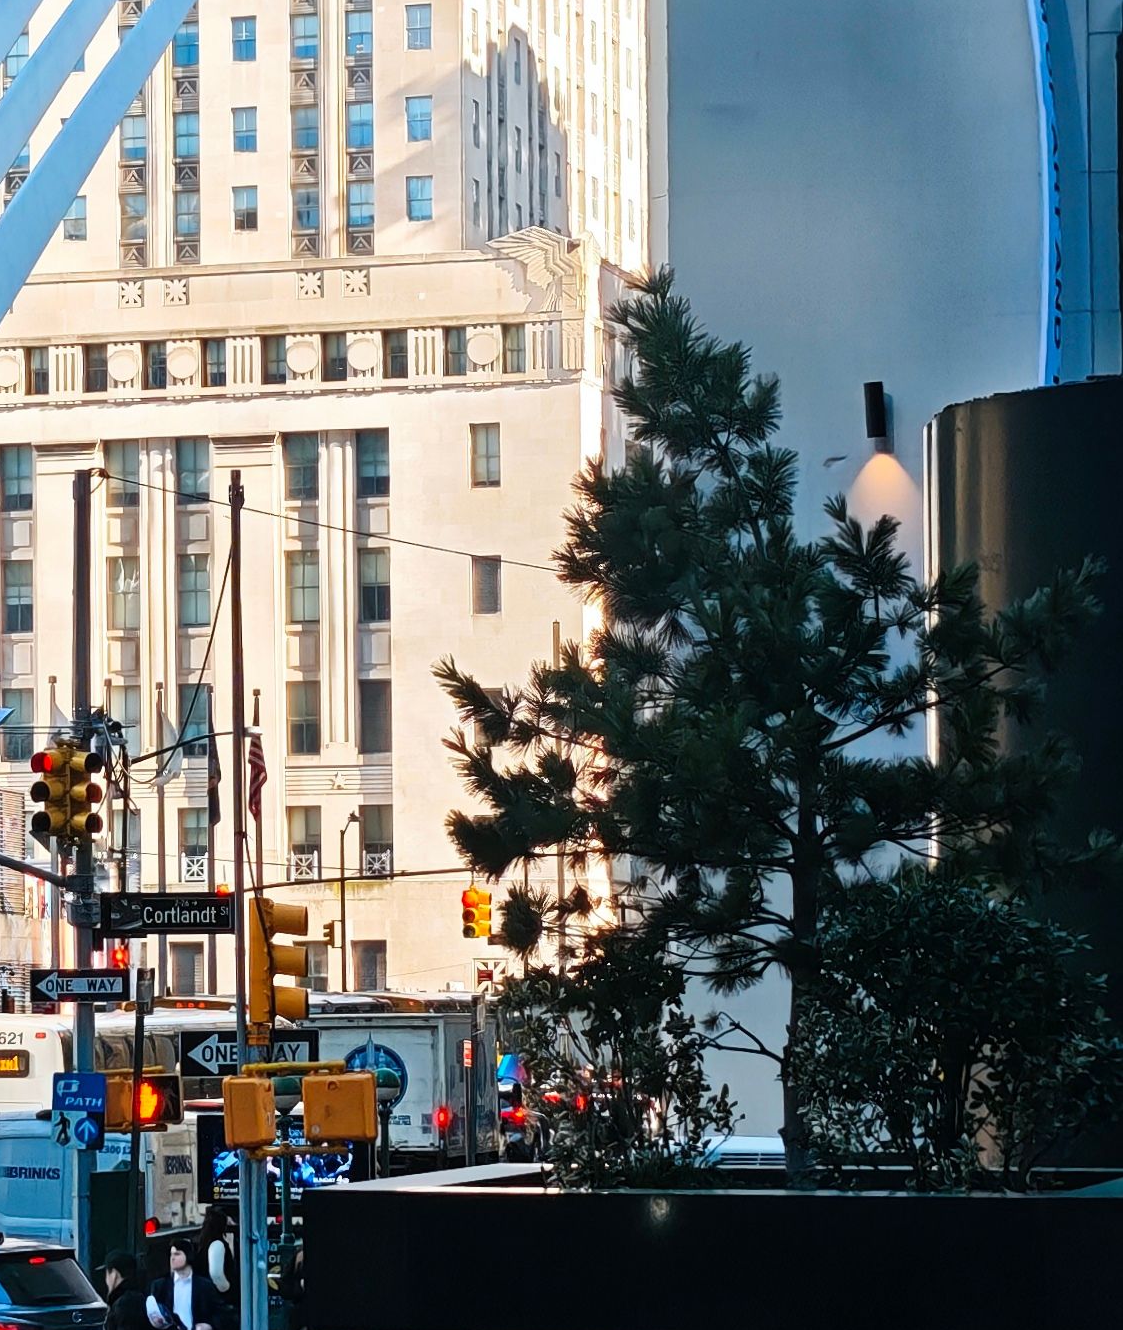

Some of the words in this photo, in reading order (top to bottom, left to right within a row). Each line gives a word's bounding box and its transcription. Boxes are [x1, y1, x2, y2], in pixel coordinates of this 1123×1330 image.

[143, 906, 217, 923] Cortlandt
[219, 906, 229, 916] St
[45, 979, 73, 992] ONE
[86, 979, 117, 992] WAY
[201, 1045, 238, 1063] ONE
[65, 1097, 103, 1107] PATH
